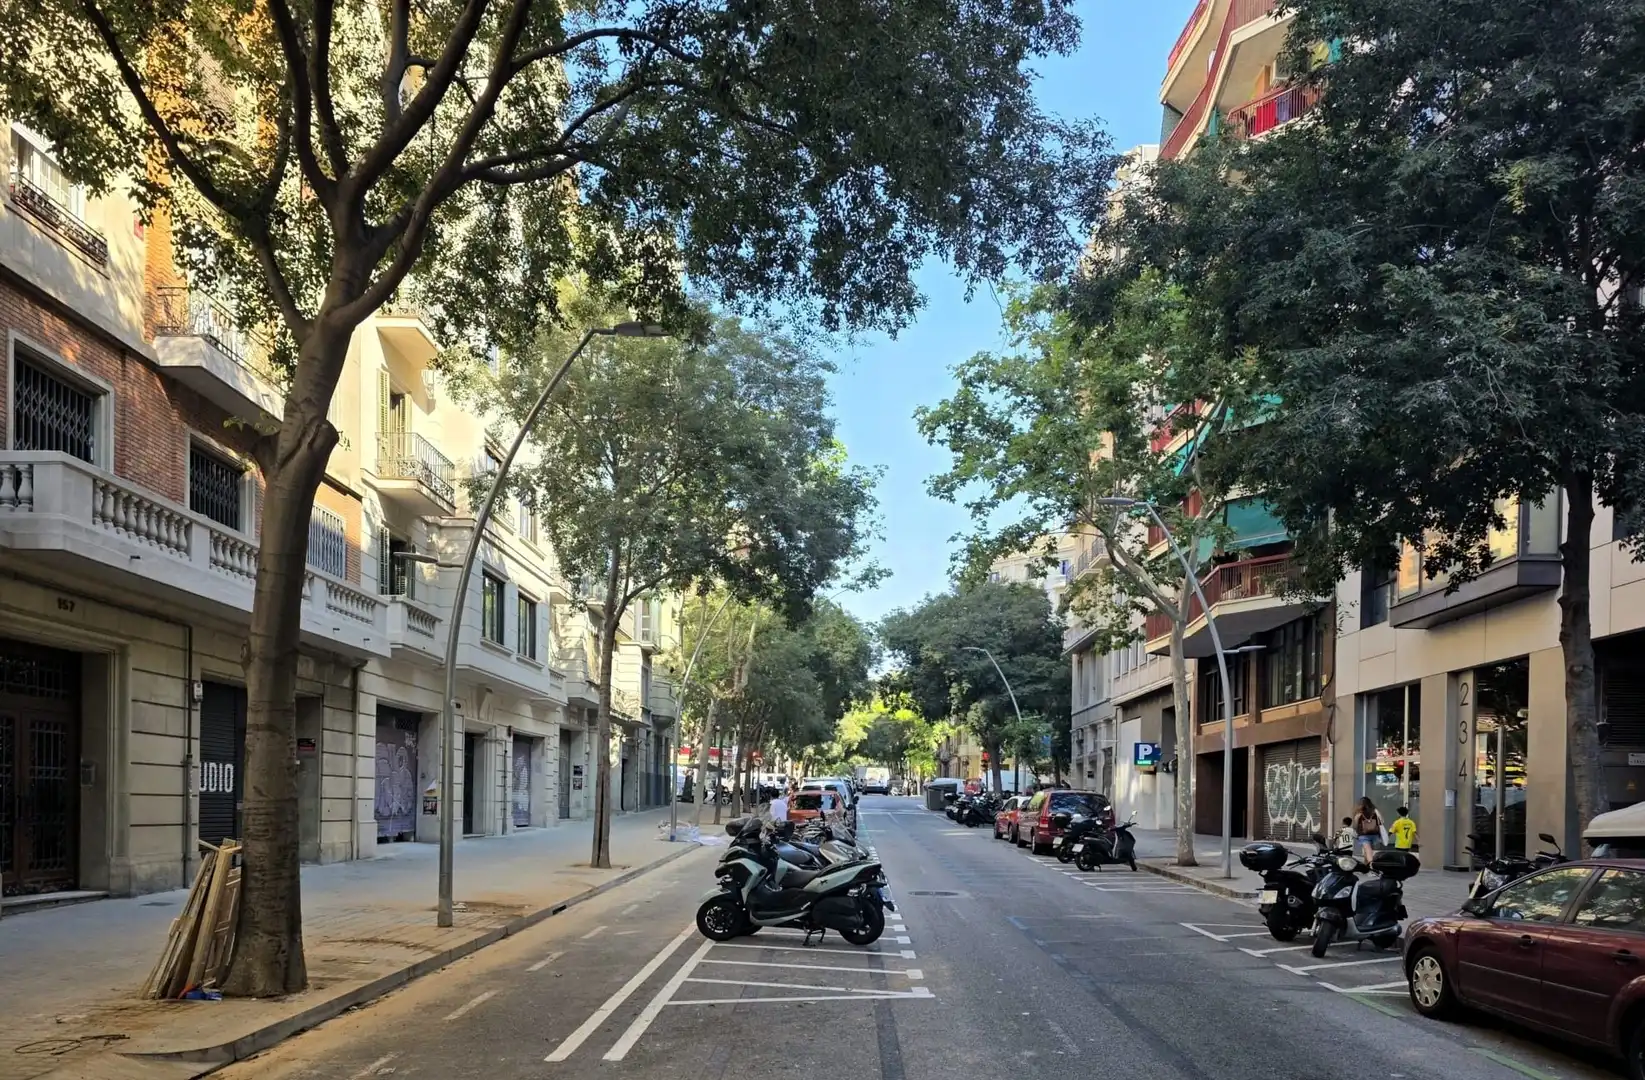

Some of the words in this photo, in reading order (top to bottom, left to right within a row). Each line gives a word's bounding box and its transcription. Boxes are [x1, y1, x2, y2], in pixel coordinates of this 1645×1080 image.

[57, 597, 75, 613] 157
[1138, 744, 1153, 760] P
[1341, 833, 1350, 843] 10
[1403, 826, 1411, 840] 7
